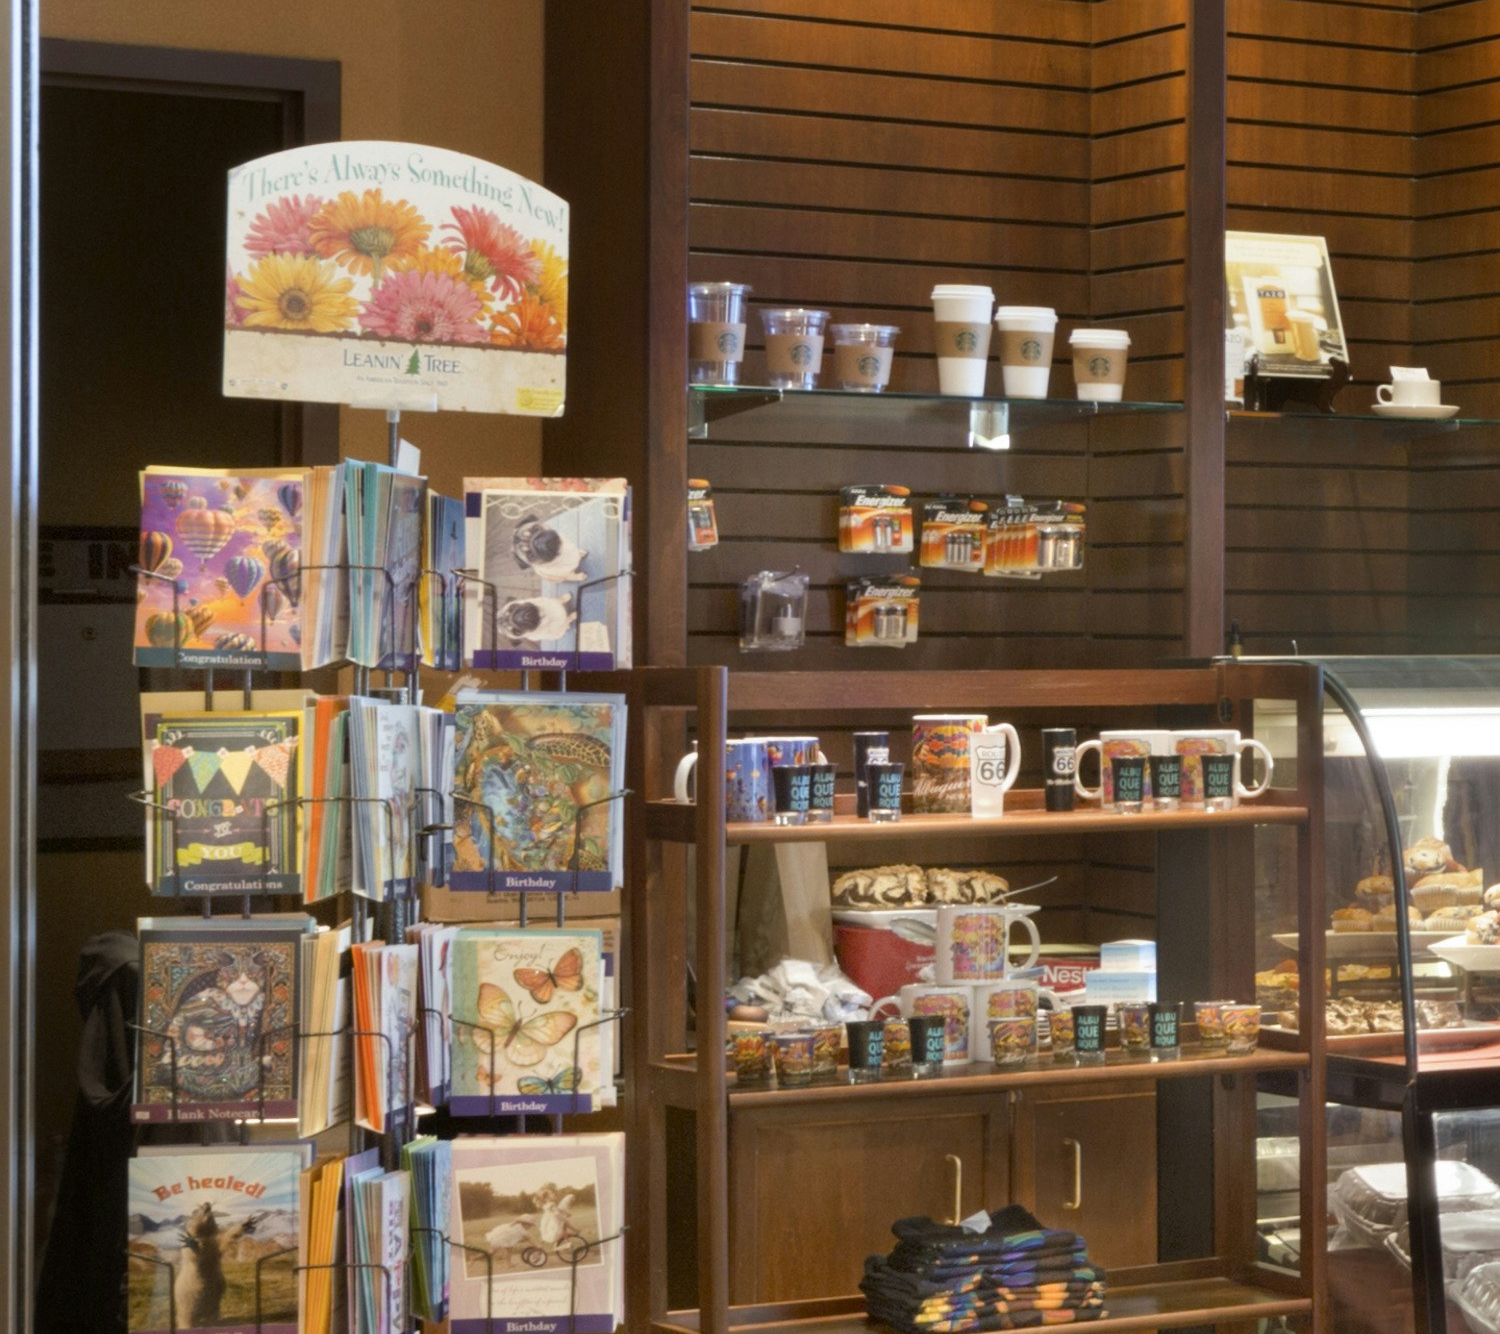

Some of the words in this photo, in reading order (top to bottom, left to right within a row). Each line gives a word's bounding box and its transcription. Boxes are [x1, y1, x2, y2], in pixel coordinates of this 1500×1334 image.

[242, 159, 319, 203] There's
[322, 153, 401, 185] Always
[406, 152, 513, 208] Something
[517, 183, 565, 233] New!
[424, 354, 462, 374] TREE
[855, 495, 906, 508] Energizer
[936, 510, 983, 524] Energizer
[1028, 513, 1066, 522] Energizer
[864, 586, 916, 599] Energizer
[179, 651, 266, 666] Congratulation
[521, 655, 568, 668] Birthday
[1056, 757, 1074, 771] 66
[981, 761, 1005, 781] 66
[1119, 778, 1140, 790] QUE
[1158, 773, 1180, 785] QUE
[1208, 773, 1229, 785] QUE
[202, 845, 242, 860] YOU
[506, 876, 557, 890] Birthday
[494, 943, 545, 965] Enjoy!
[1077, 1026, 1099, 1038] QUE
[1155, 1023, 1177, 1035] QUE
[500, 1099, 548, 1114] Birthday
[208, 1108, 265, 1119] Notecar
[152, 1182, 184, 1203] Be
[187, 1175, 267, 1199] healed!
[506, 1321, 557, 1333] Birthday
